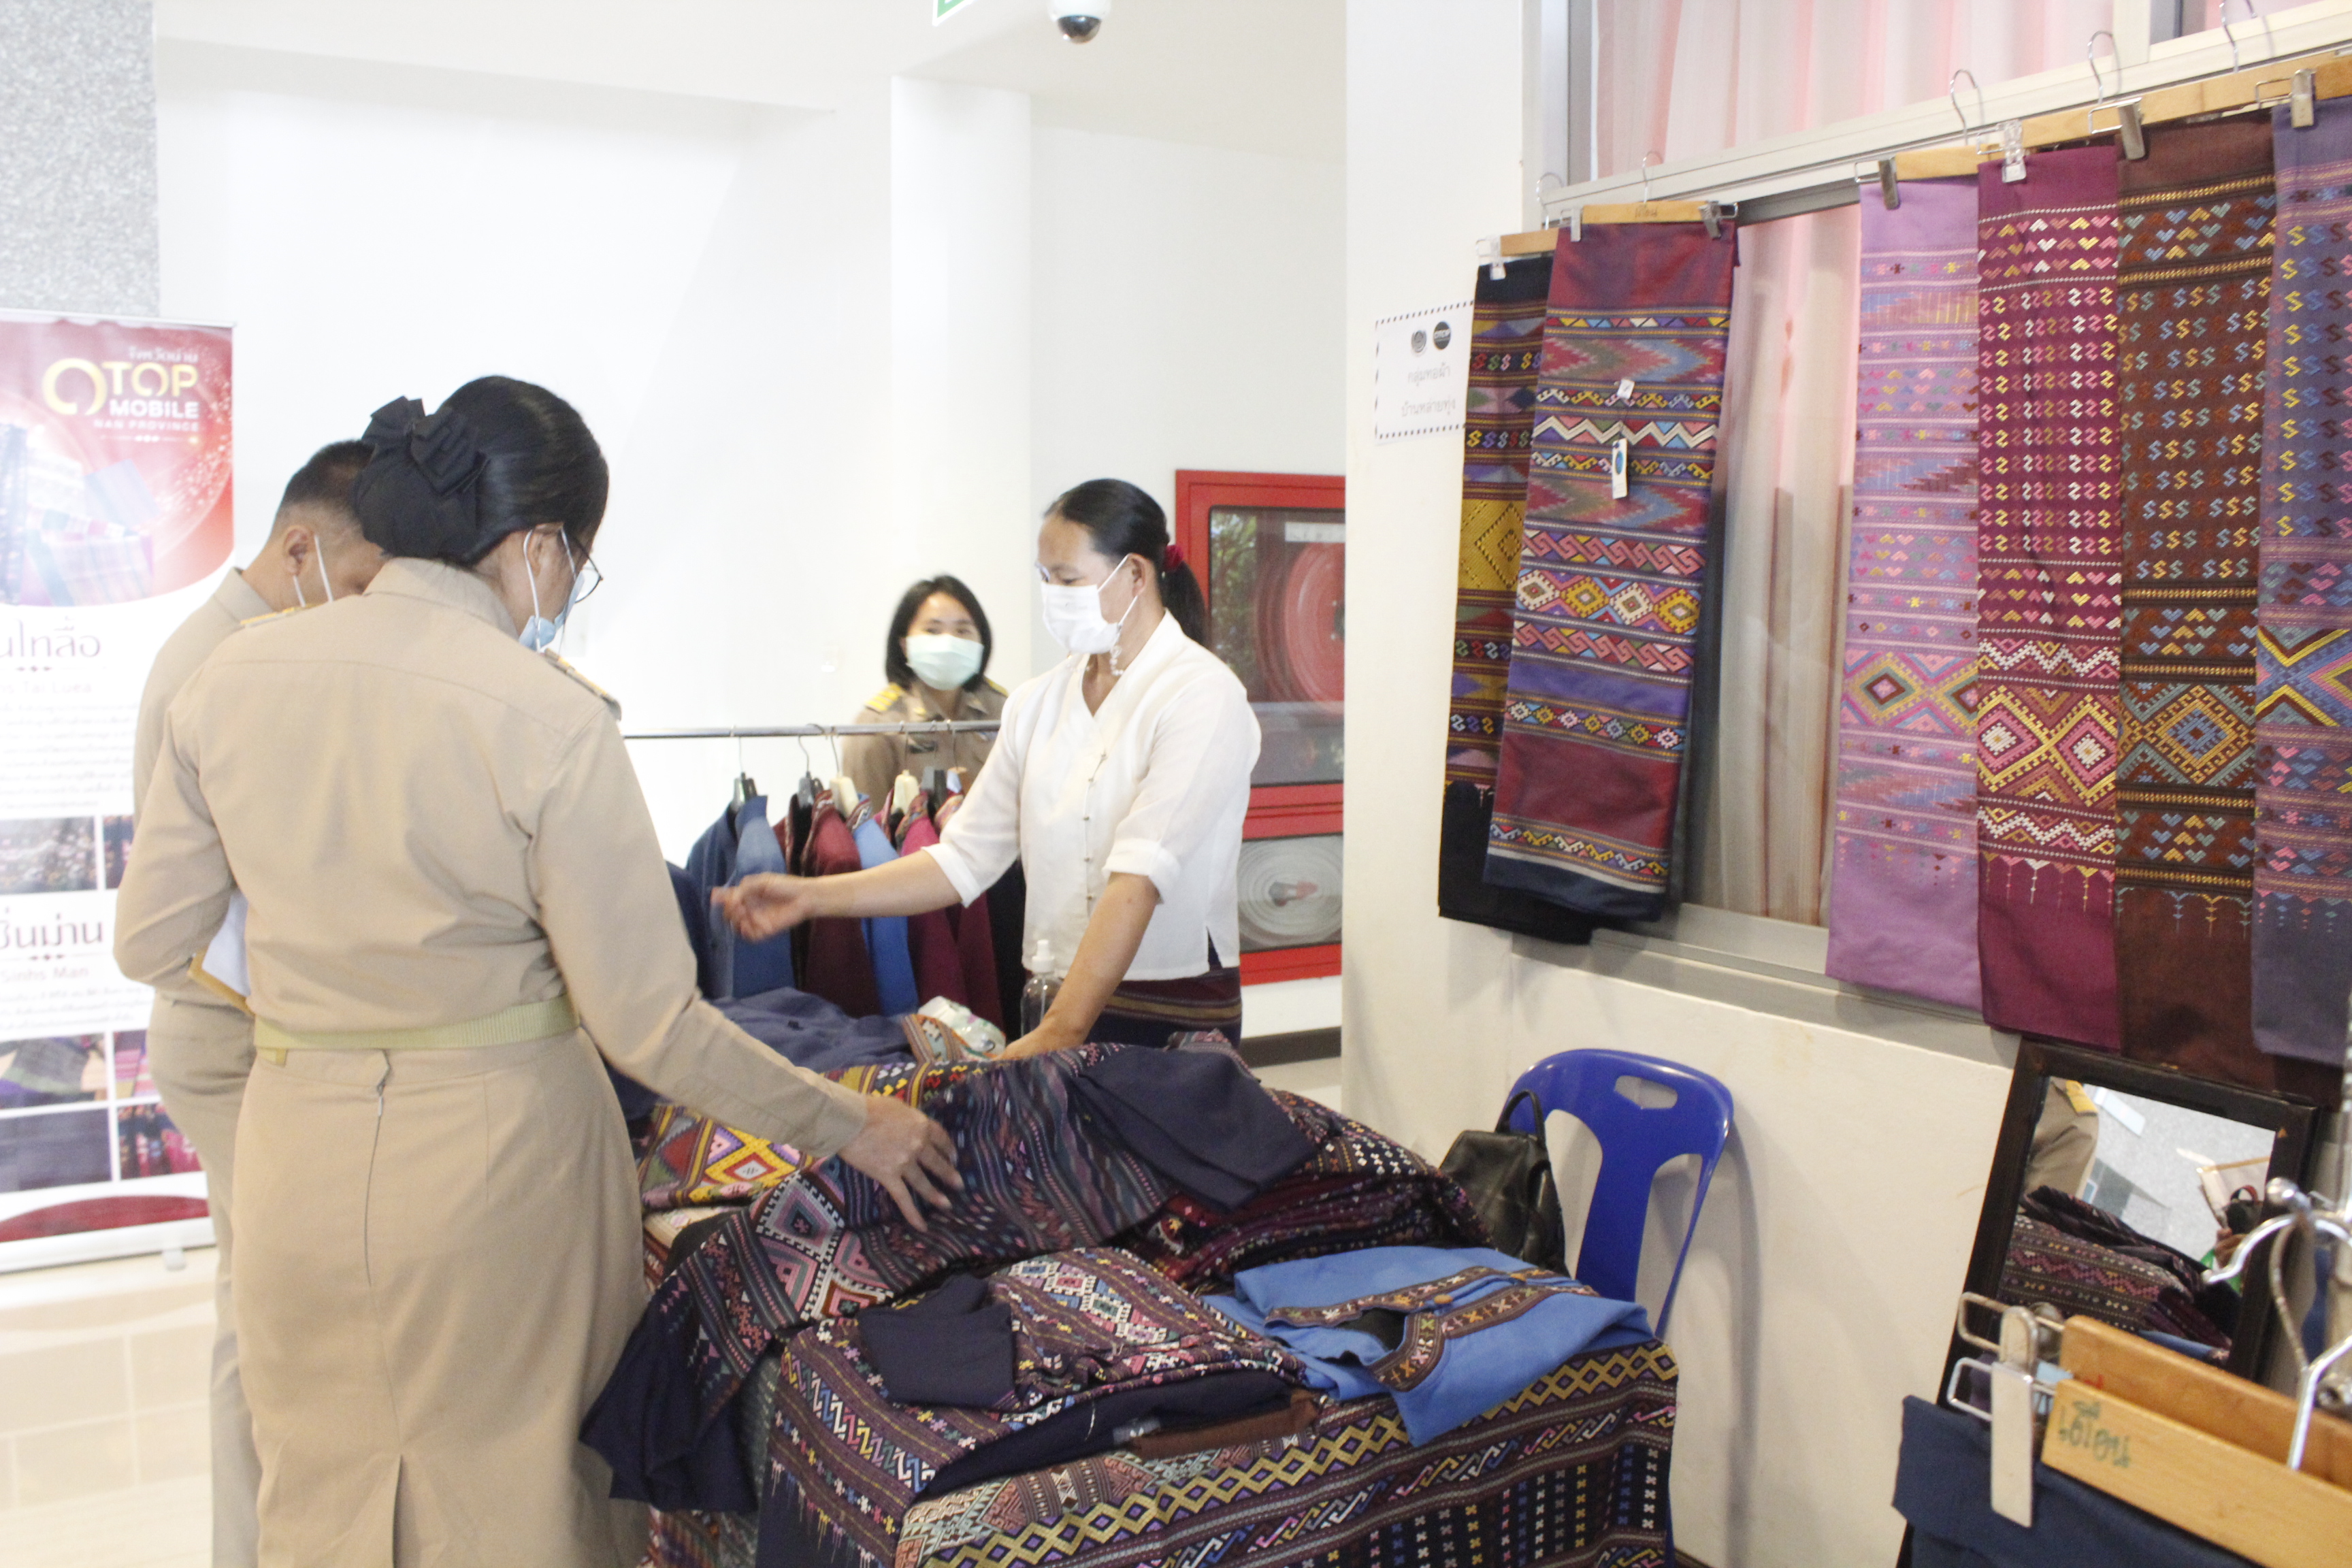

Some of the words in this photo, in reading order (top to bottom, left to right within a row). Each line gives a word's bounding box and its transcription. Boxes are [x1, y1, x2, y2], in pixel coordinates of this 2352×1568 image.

[42, 357, 199, 416] OTOP
[109, 399, 199, 419] MOBILE
[93, 419, 124, 429] NAN
[129, 420, 199, 432] PROVINCE
[53, 965, 89, 979] Man
